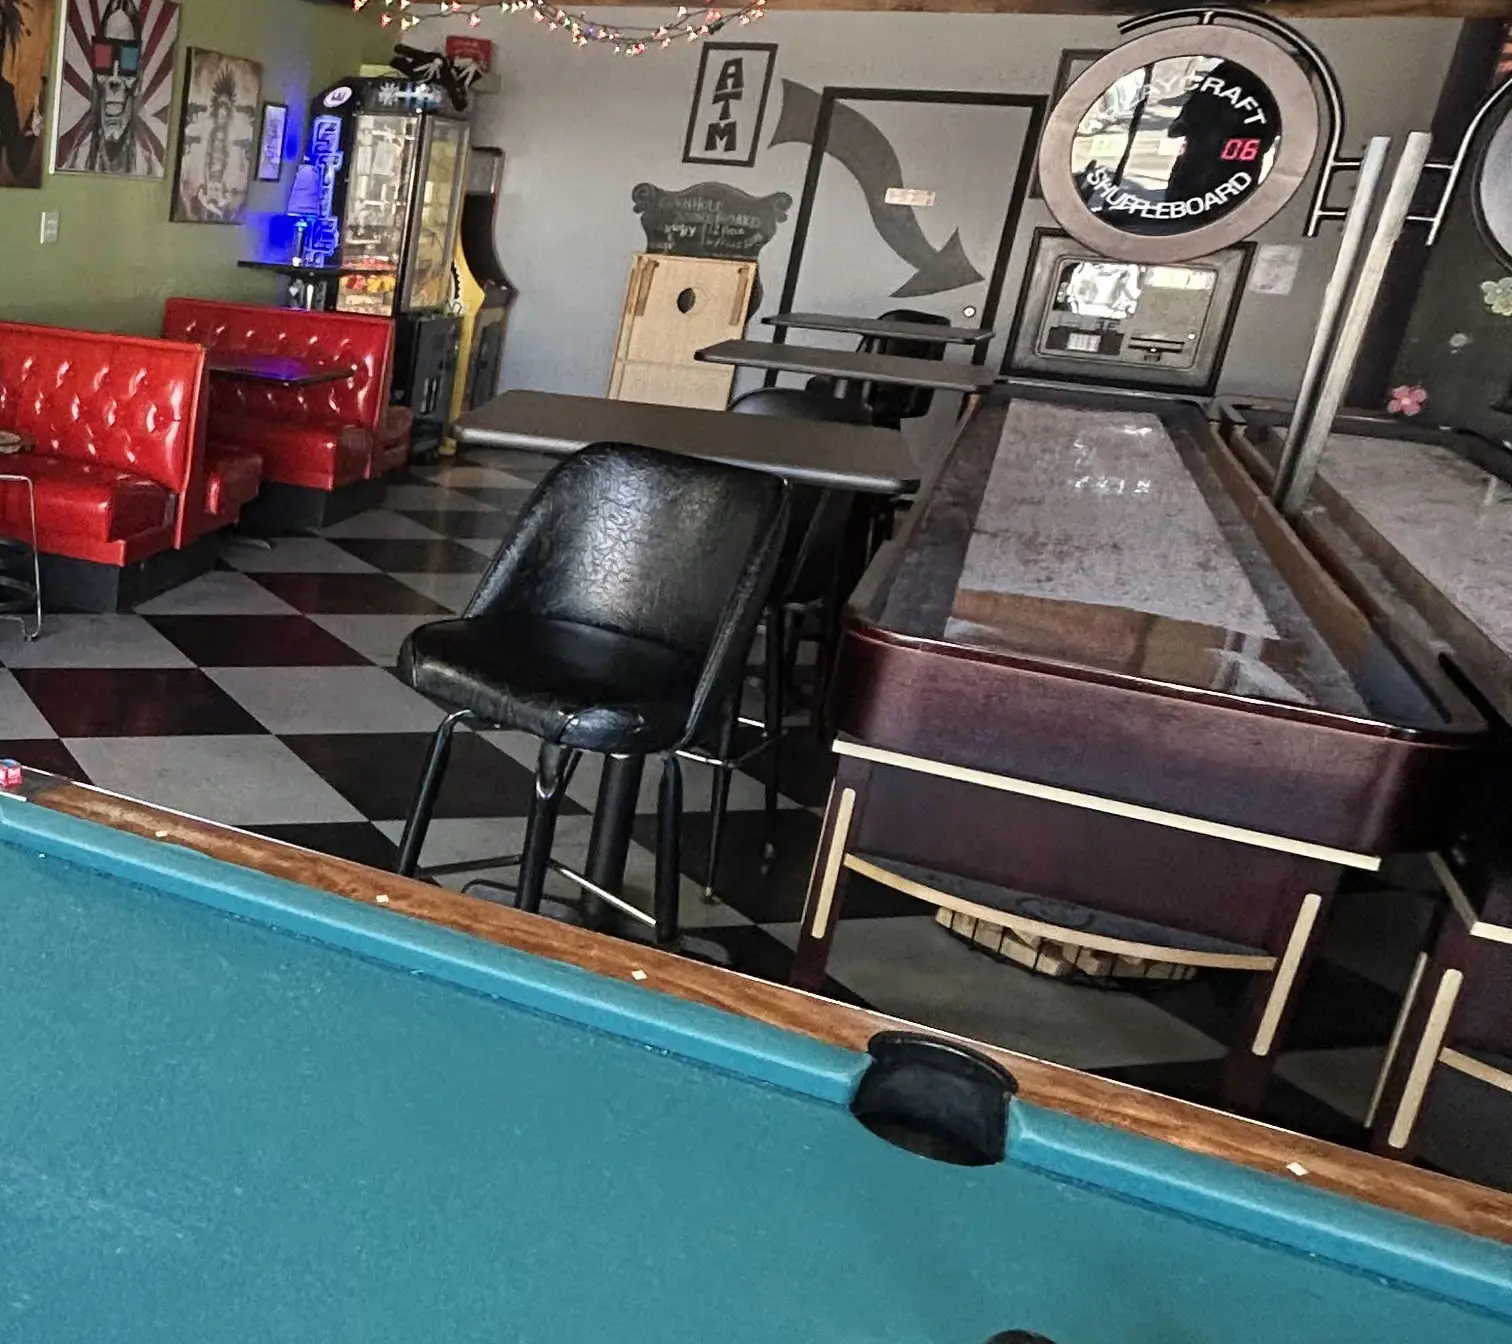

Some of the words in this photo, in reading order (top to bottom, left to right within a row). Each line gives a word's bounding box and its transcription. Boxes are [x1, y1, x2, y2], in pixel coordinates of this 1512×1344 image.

[703, 56, 744, 153] ATM
[1220, 138, 1262, 161] 06
[1086, 168, 1253, 220] SHUFFLEBOARD
